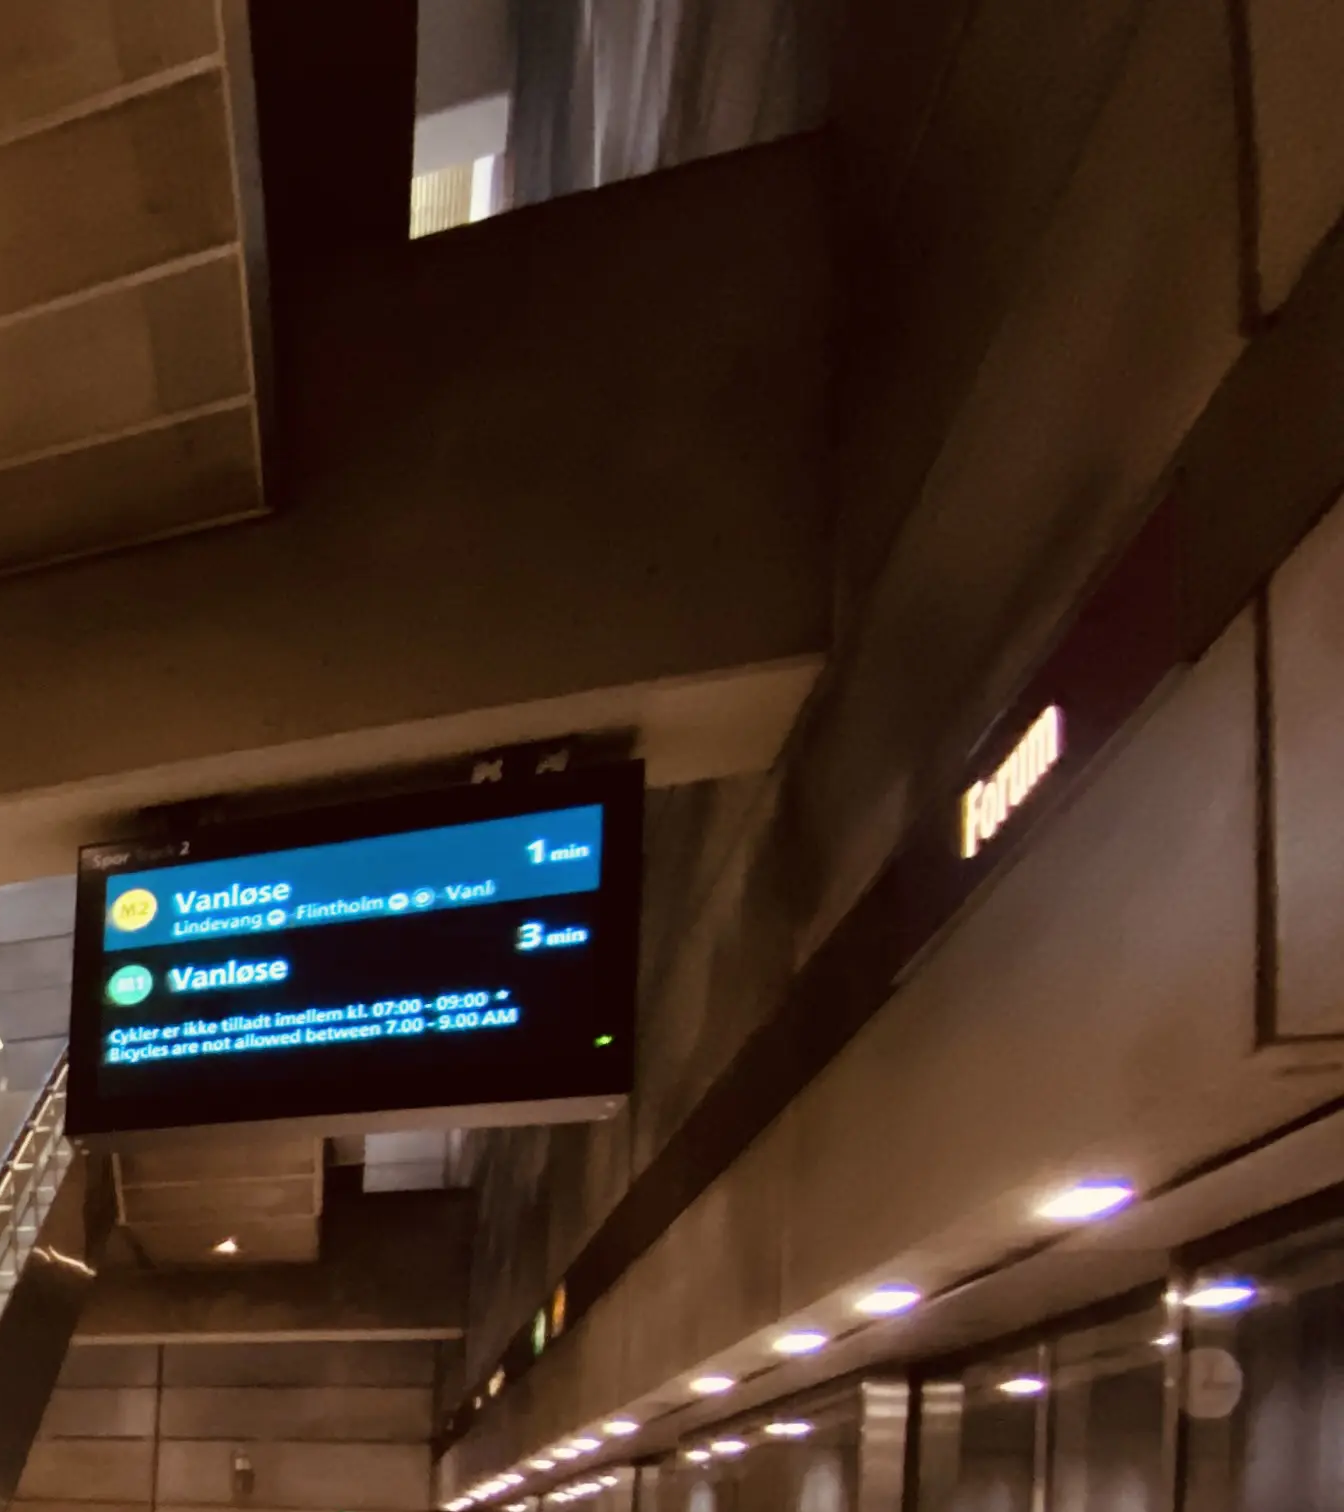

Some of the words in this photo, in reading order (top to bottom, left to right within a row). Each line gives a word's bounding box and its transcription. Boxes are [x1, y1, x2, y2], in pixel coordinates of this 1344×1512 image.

[961, 703, 1062, 859] Forum
[178, 840, 190, 856] 2
[527, 839, 545, 864] 1
[550, 843, 590, 861] min
[174, 882, 290, 914] Vanløse
[173, 913, 262, 936] Lindevang
[296, 895, 384, 920] Flintholm
[515, 922, 542, 951] 3
[546, 927, 588, 946] min
[168, 958, 289, 992] Vanløse
[109, 1045, 169, 1063] Bicycles
[171, 1043, 199, 1057] are
[202, 1037, 231, 1051] not
[234, 1028, 301, 1048] allowed
[305, 1023, 381, 1044] between
[385, 1017, 424, 1035] 7.00
[481, 1006, 519, 1025] AM
[110, 1026, 159, 1046] Cykler
[162, 1026, 180, 1039] er
[183, 1019, 217, 1036] ikke
[221, 1014, 271, 1033] tilladt
[275, 1008, 343, 1027] imellem
[346, 1003, 367, 1019] kl.
[372, 998, 422, 1017] 07:00
[436, 992, 488, 1011] 09:00
